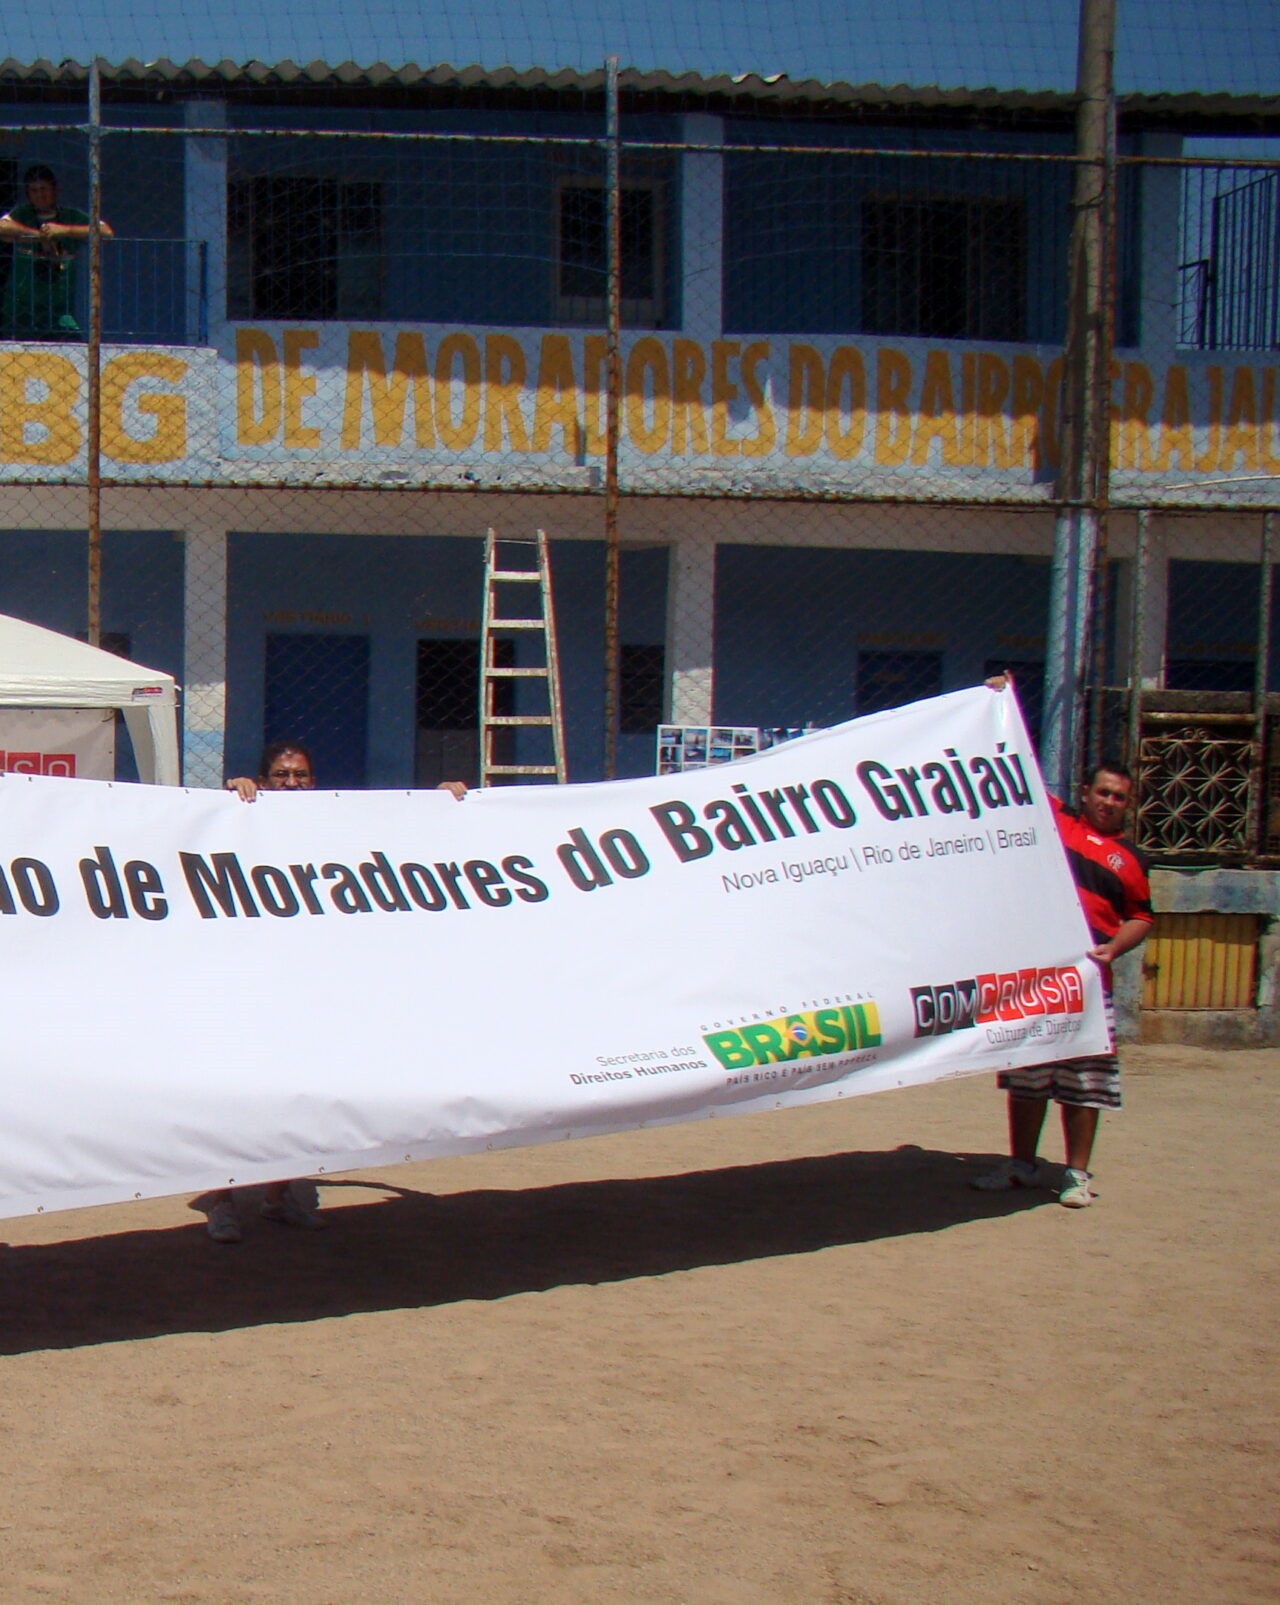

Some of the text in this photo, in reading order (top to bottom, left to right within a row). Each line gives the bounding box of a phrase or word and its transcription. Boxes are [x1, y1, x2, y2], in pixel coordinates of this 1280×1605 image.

[235, 327, 319, 449] DE
[339, 330, 777, 458] MORADORES
[785, 343, 867, 461] DO
[78, 845, 170, 921] de
[178, 850, 549, 919] Moradores
[555, 827, 652, 893] do
[648, 777, 857, 864] Bairro
[855, 741, 1035, 822] Grajaú
[721, 867, 779, 893] Nova
[781, 853, 849, 883] Iguaçu
[863, 846, 894, 866] Rio
[898, 842, 921, 862] de
[925, 834, 985, 858] Janeiro
[996, 827, 1037, 850] Brasil
[699, 991, 876, 1032] GOVERNO FEDERAL
[913, 971, 1082, 1029] COMCAUSA
[595, 1043, 697, 1068] Secretaria dos
[702, 1001, 882, 1070] BRASIL
[985, 1018, 1082, 1045] Cultura de Direitos
[568, 1058, 708, 1087] Direitos Humanos
[752, 1070, 778, 1082] RICO
